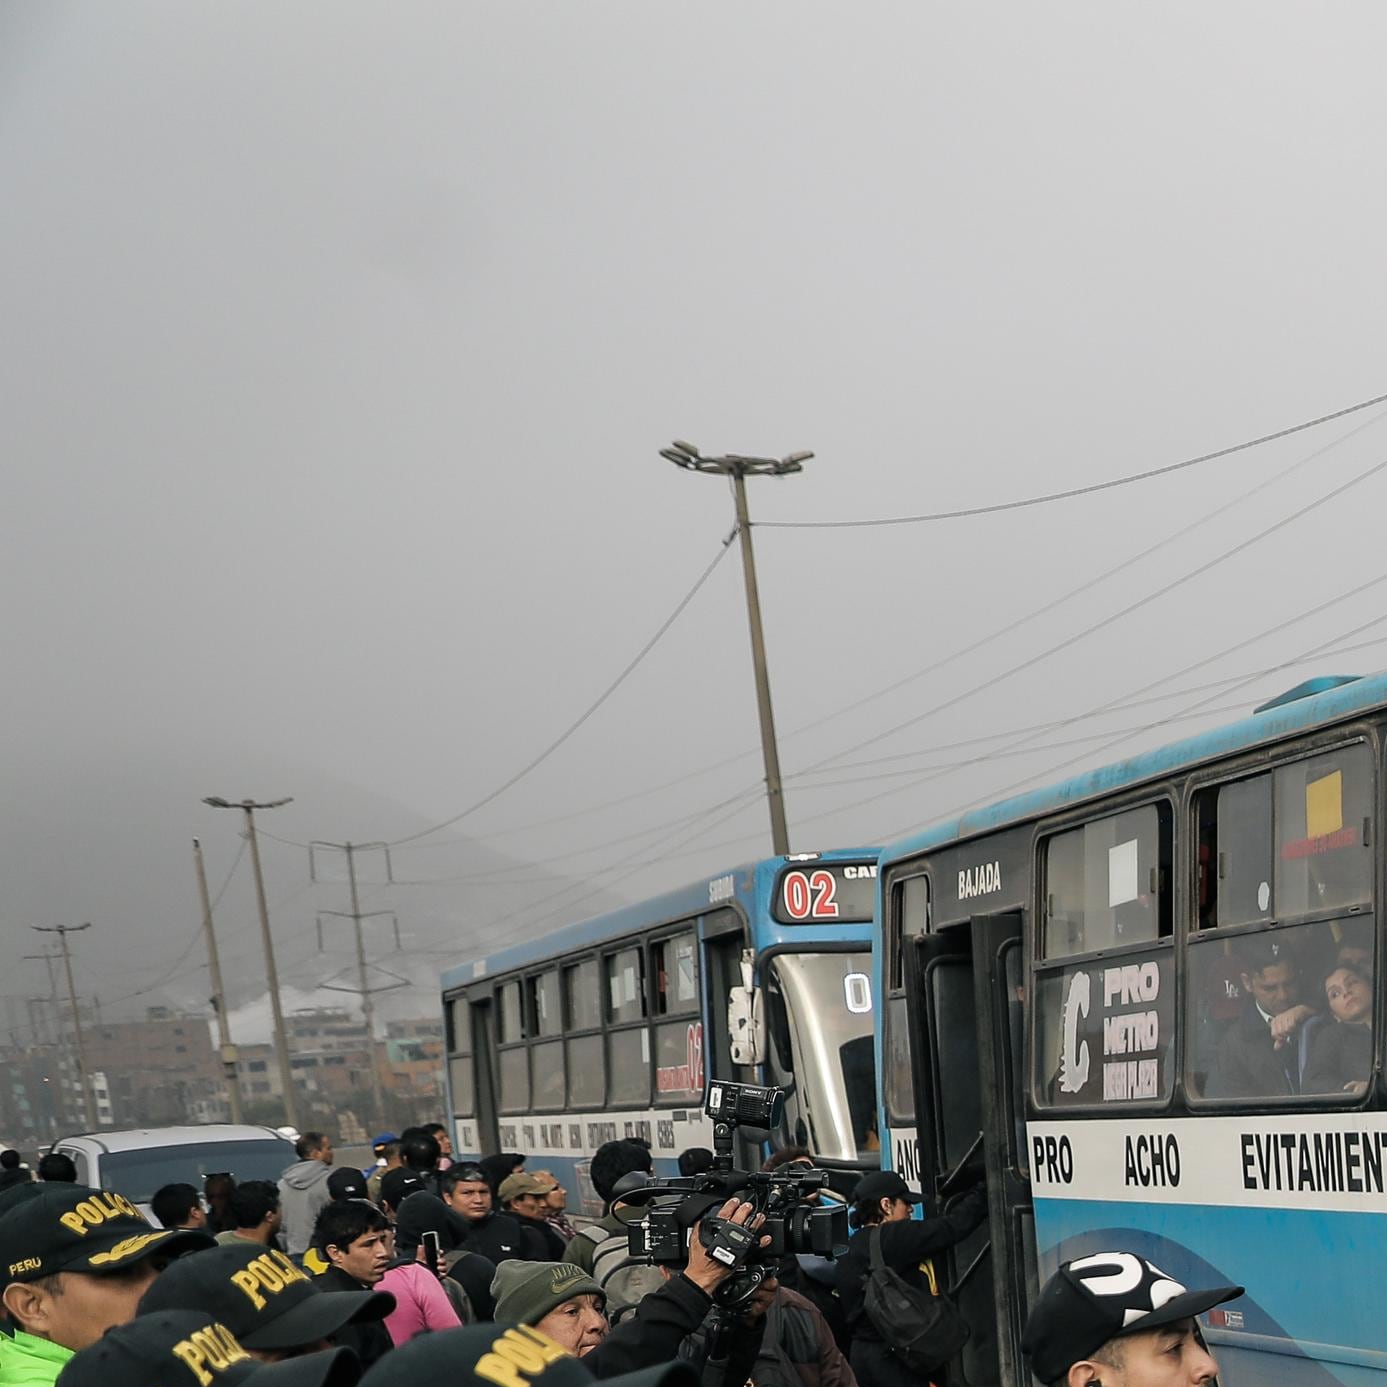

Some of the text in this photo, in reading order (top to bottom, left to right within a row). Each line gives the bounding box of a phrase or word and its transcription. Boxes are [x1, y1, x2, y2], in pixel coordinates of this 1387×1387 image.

[784, 870, 838, 919] 02
[958, 861, 1001, 900] BAJADA
[1103, 961, 1160, 1008] PRO
[1103, 1010, 1159, 1056] METRO
[1033, 1135, 1073, 1184] PRO
[1125, 1133, 1181, 1188] ACHO
[9, 1256, 42, 1277] PERU
